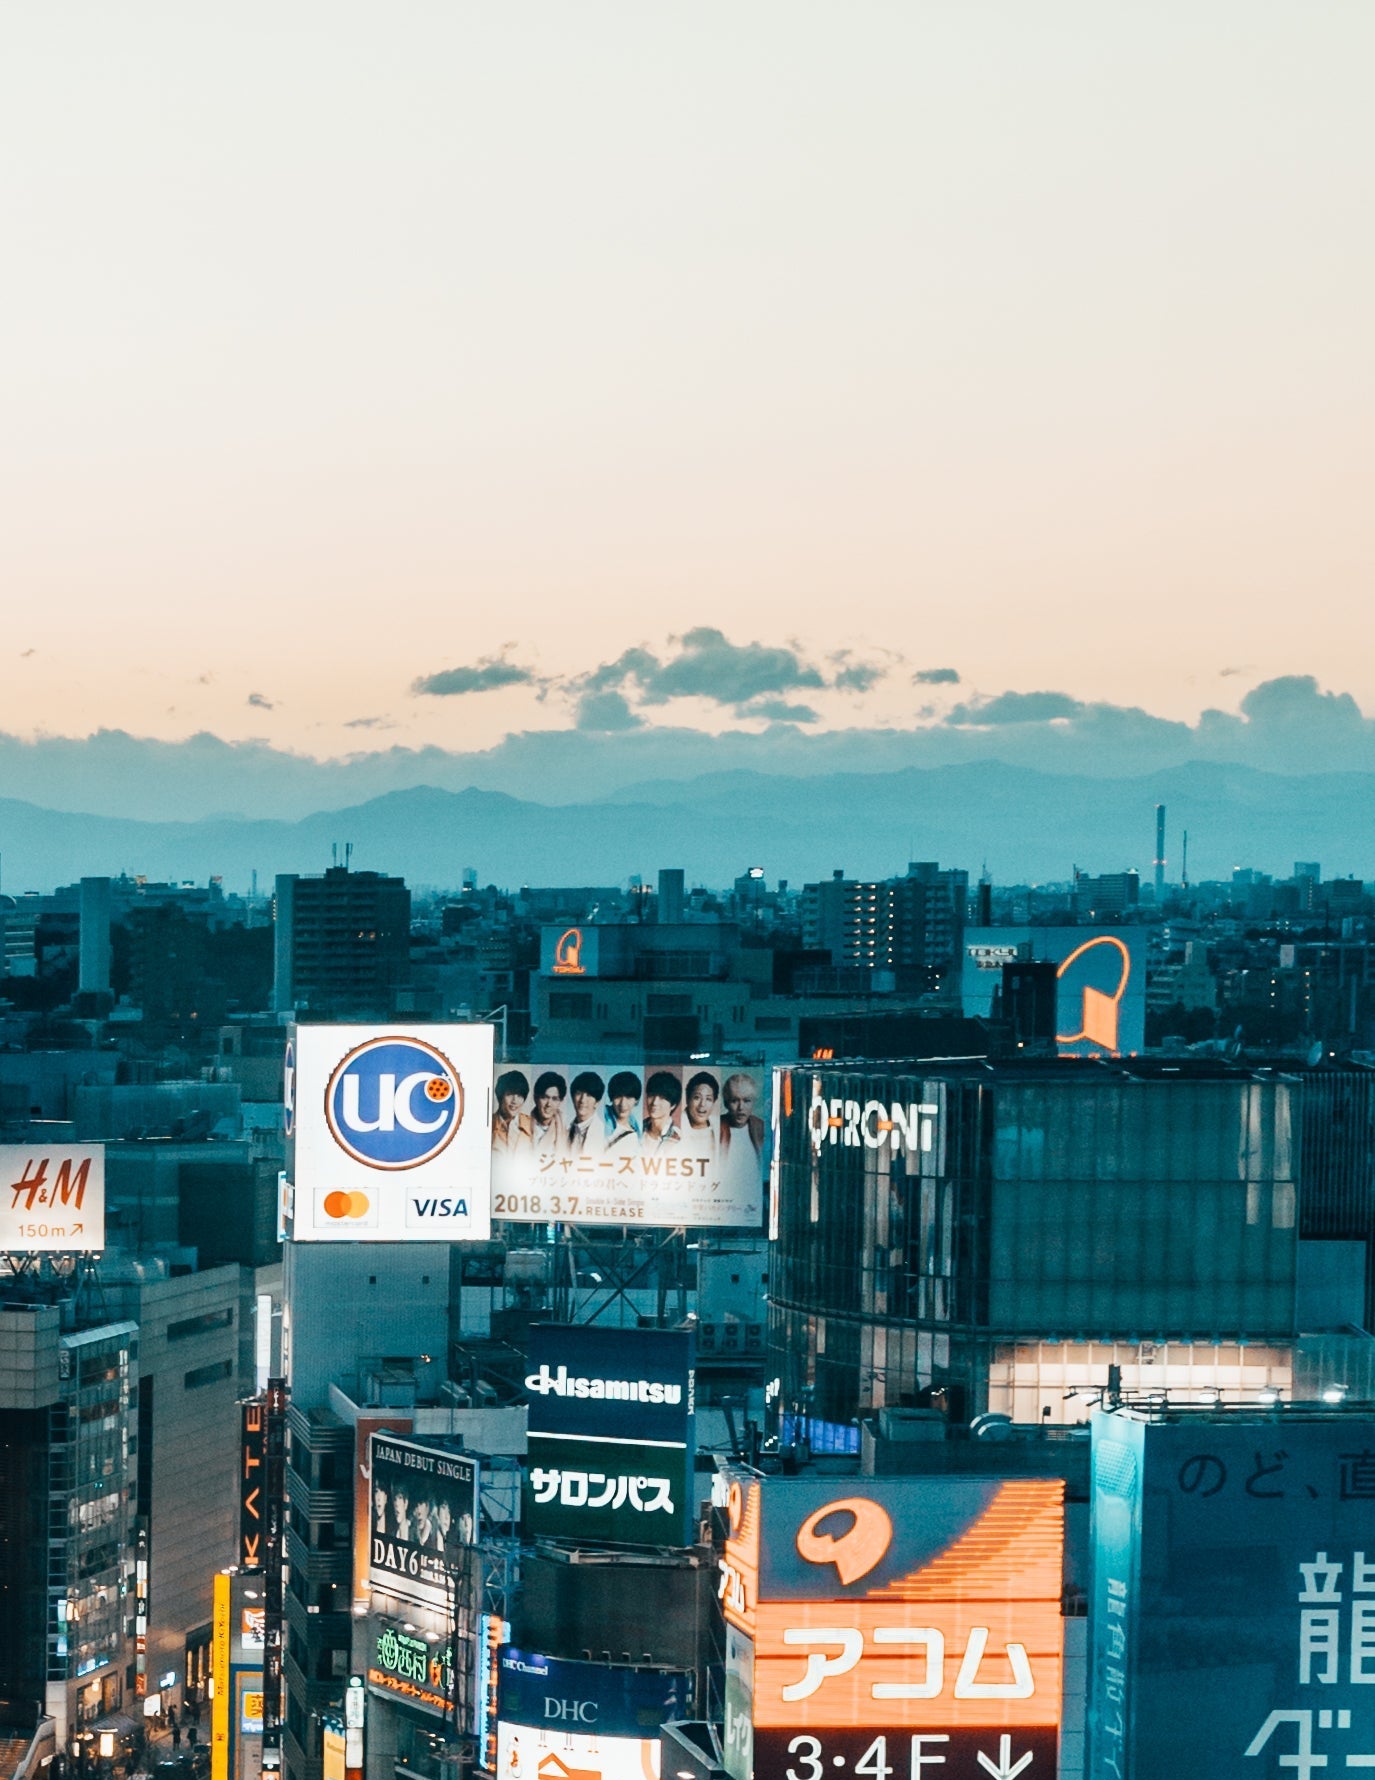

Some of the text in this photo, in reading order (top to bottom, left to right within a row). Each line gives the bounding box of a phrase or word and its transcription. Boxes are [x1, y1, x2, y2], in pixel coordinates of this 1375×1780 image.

[10, 1157, 92, 1211] H&M
[412, 1198, 468, 1217] VISA
[585, 1206, 645, 1218] RELEASE
[18, 1224, 66, 1238] 150m
[524, 1364, 682, 1405] Hisamitsu
[375, 1444, 473, 1483] JAPAN DEBUT SINGLE
[530, 1467, 674, 1515] サロンパス
[373, 1538, 419, 1576] DAY6
[782, 1626, 1035, 1702] アコム
[543, 1696, 599, 1724] DHC
